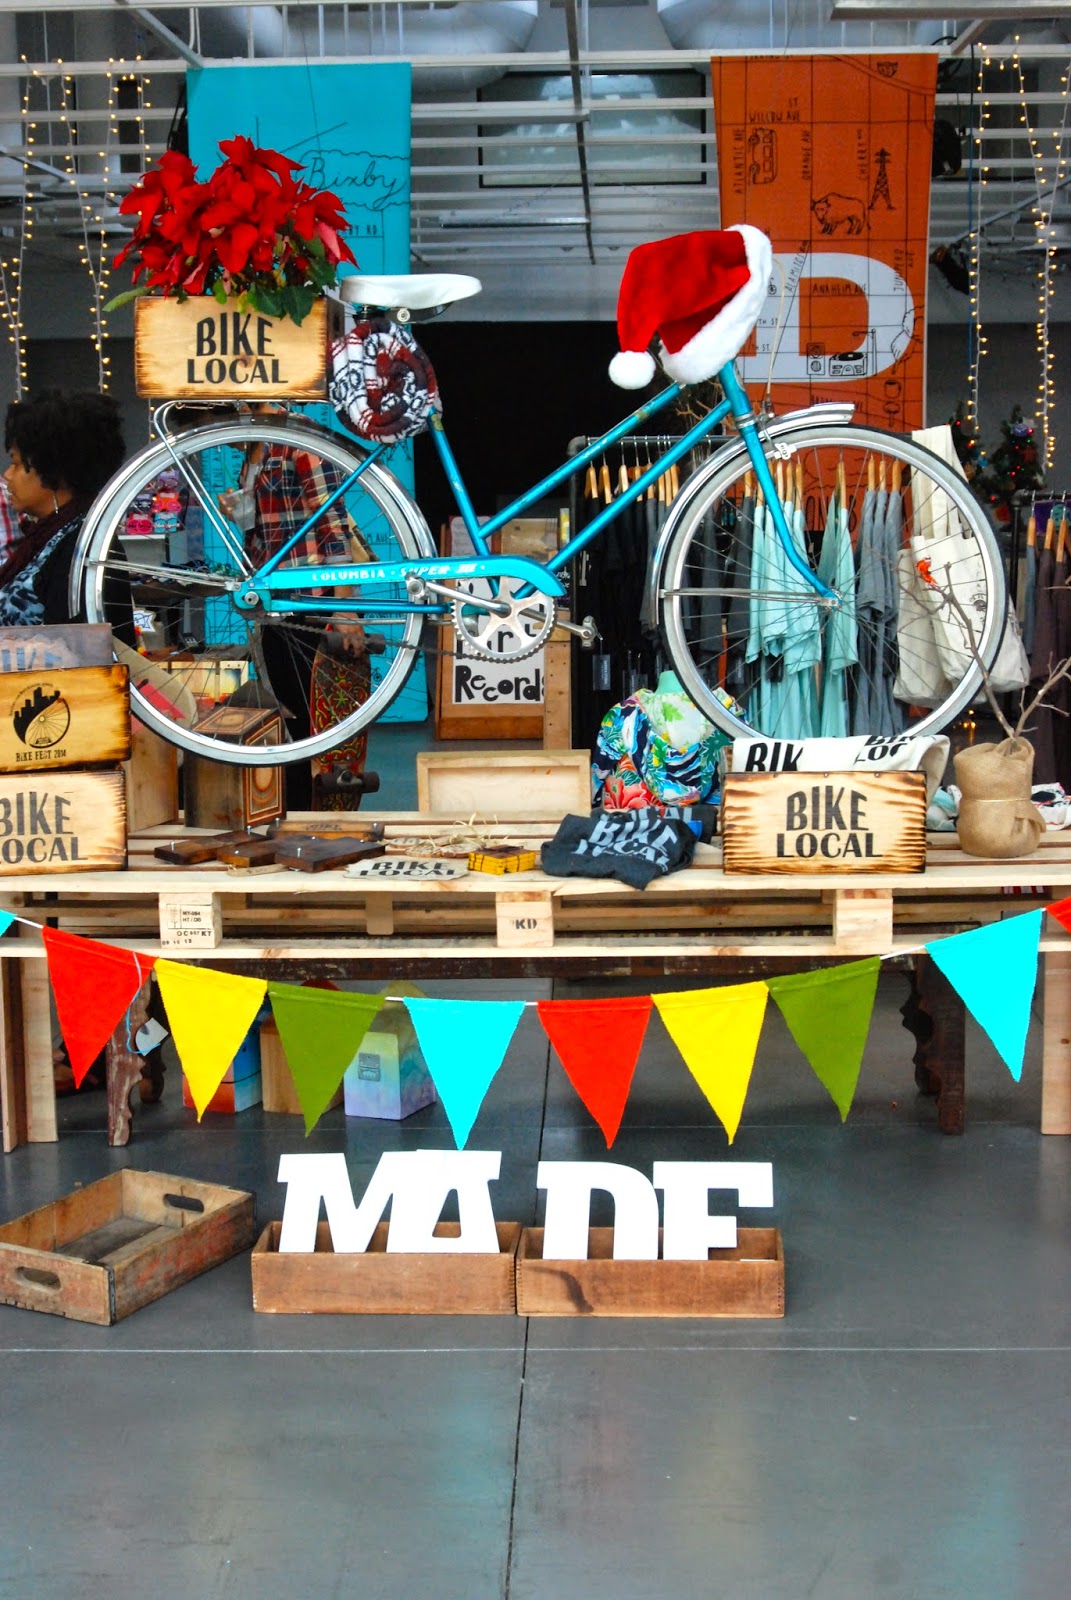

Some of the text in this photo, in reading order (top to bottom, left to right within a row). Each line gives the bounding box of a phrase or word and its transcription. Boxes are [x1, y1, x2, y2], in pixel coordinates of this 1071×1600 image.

[308, 156, 406, 210] Bixby
[733, 146, 745, 194] ATLANTIC
[196, 312, 275, 357] BIKE
[187, 358, 289, 384] LOCAL
[312, 569, 386, 581] COLUMBIA
[455, 665, 544, 703] Record
[35, 749, 52, 760] FEST
[0, 791, 74, 837] BIKE
[786, 785, 869, 831] BIKE
[0, 836, 89, 864] OCAL
[589, 819, 678, 857] BIKE
[776, 832, 883, 859] LOCAL
[371, 861, 450, 870] BIKE
